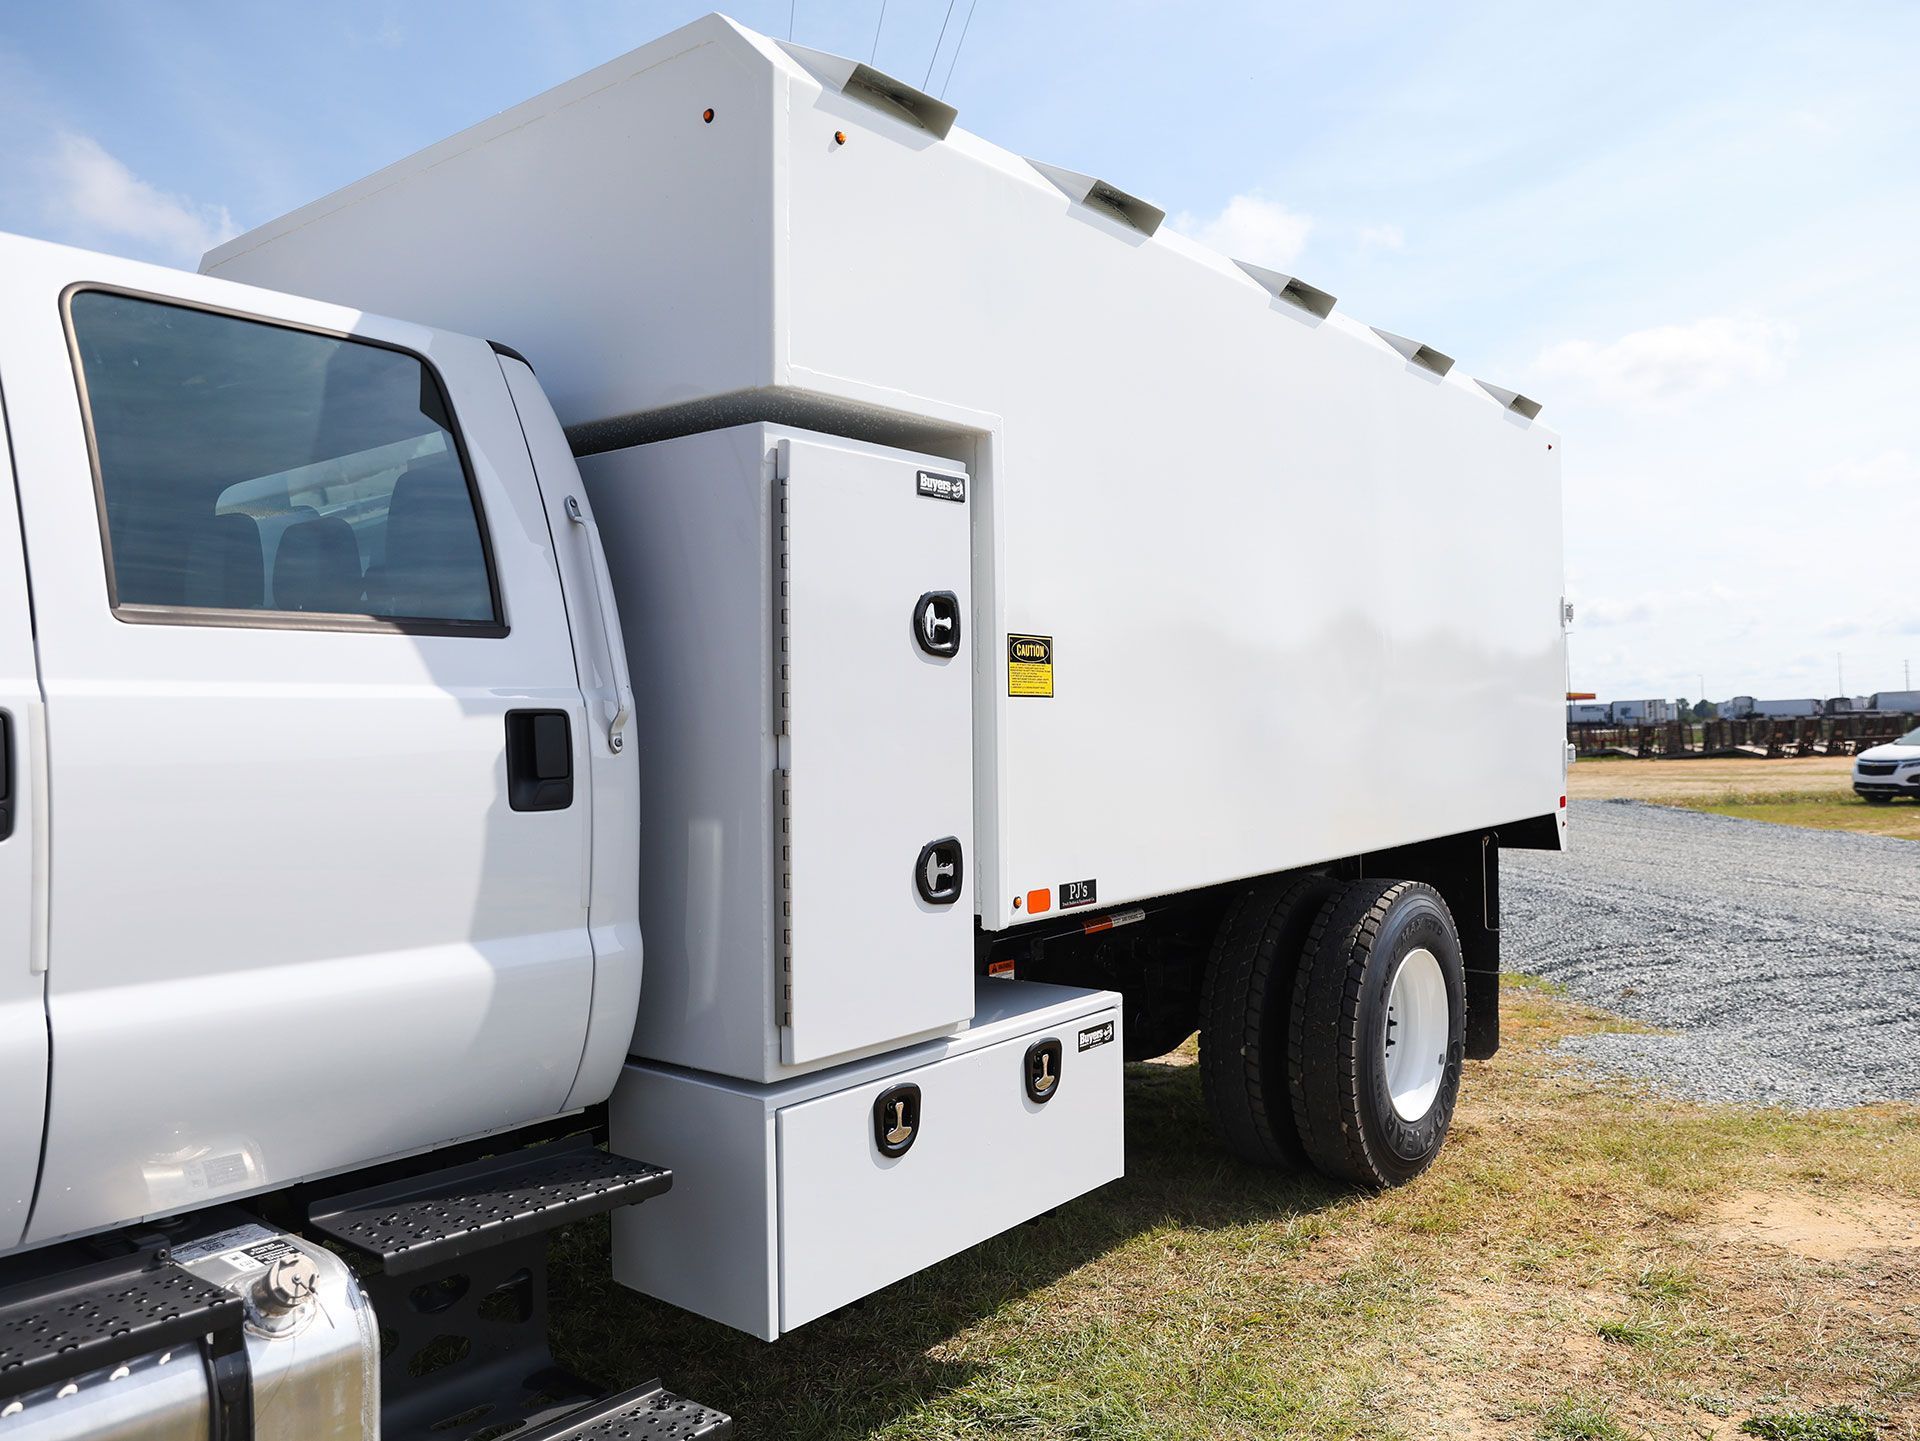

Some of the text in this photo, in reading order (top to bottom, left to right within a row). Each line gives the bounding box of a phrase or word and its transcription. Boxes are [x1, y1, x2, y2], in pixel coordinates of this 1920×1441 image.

[920, 472, 951, 492] Buyers
[1016, 643, 1045, 657] CAUTION
[1069, 882, 1088, 899] PJ's
[1080, 1029, 1104, 1045] Buyers
